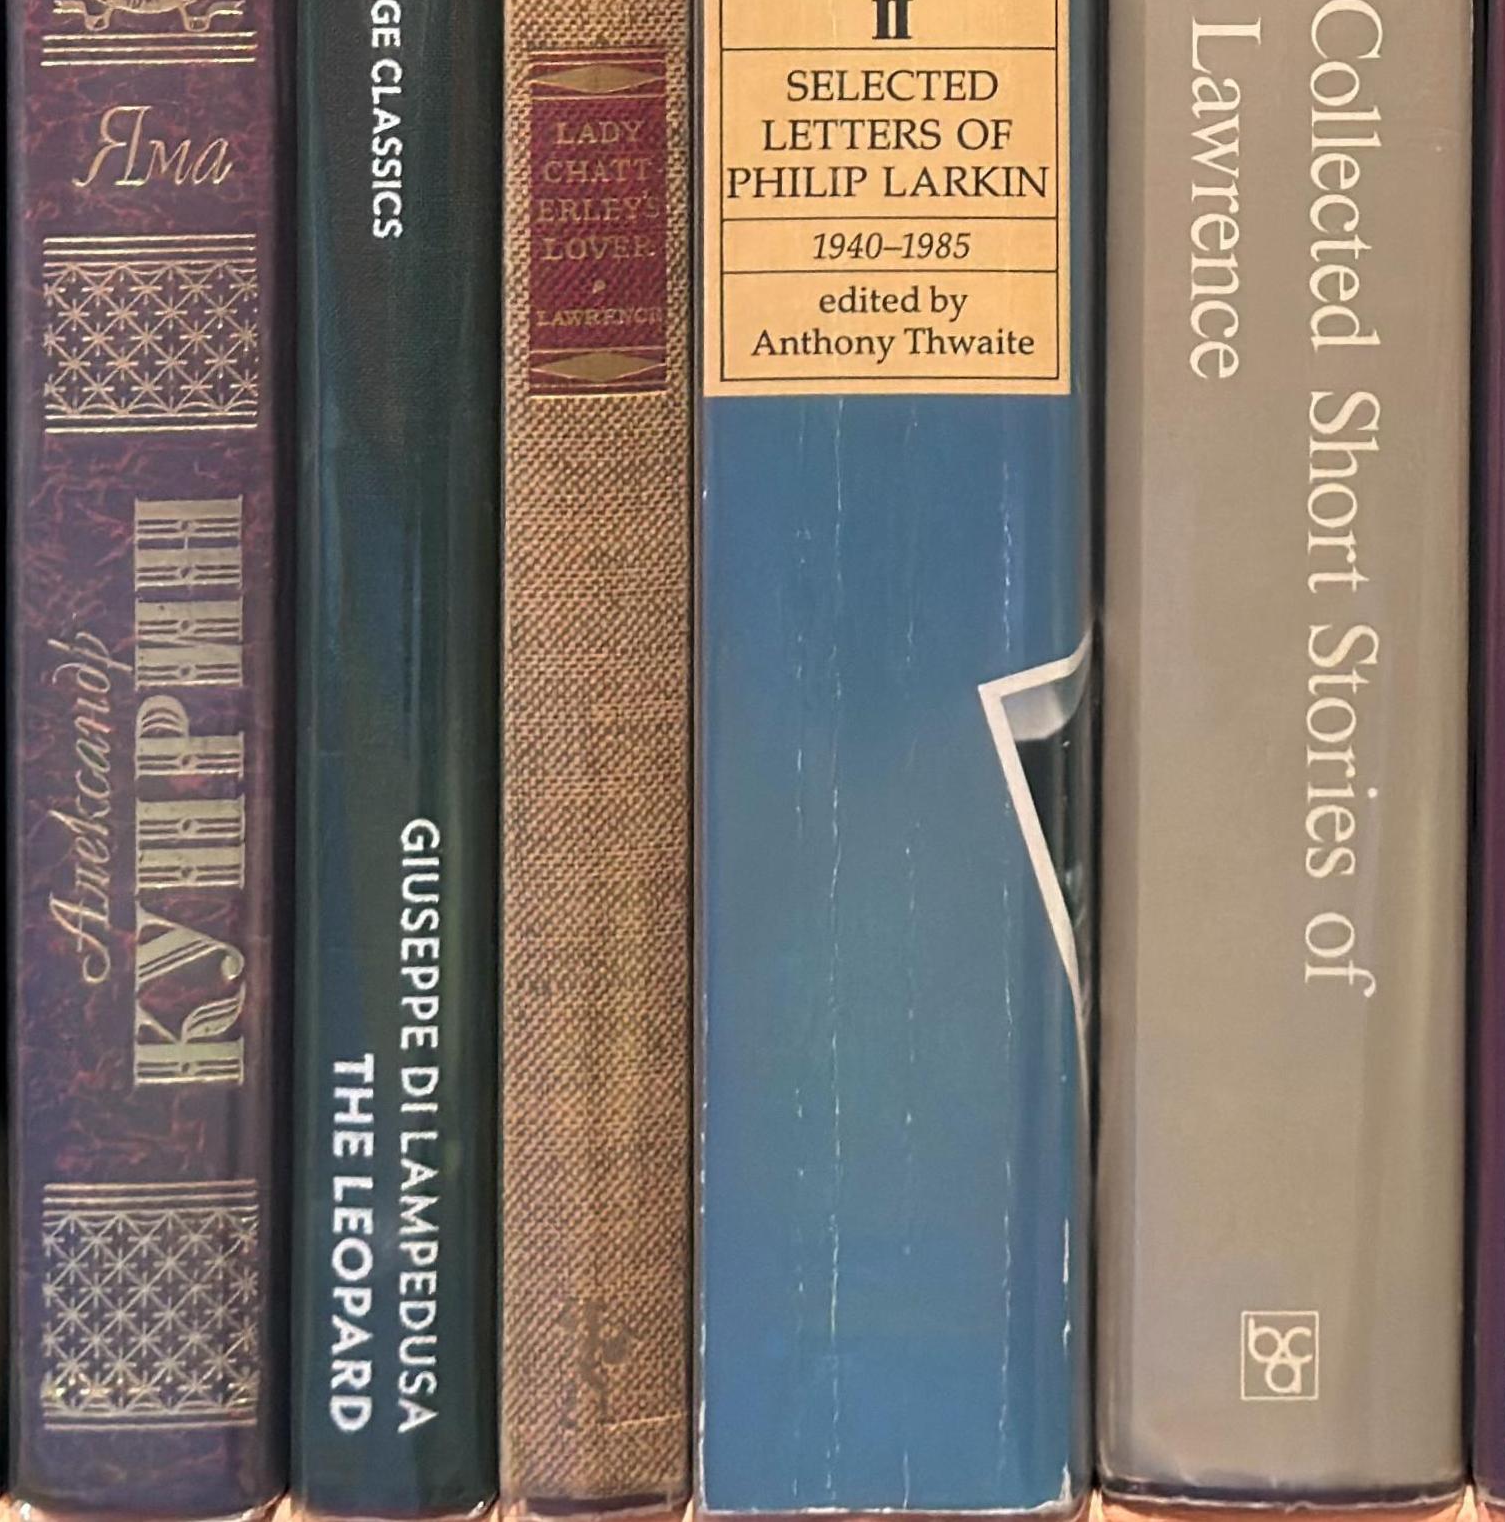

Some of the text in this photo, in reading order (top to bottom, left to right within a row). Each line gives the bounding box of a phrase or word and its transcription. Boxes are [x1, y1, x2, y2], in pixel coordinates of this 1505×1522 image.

[786, 69, 999, 103] SELECTED
[73, 105, 231, 188] Яма
[372, 62, 403, 240] CLASSICS
[544, 159, 651, 183] CHATT
[555, 121, 644, 145] LADY
[761, 118, 1012, 152] LETTERS OF
[727, 165, 1048, 201] PHILIP LARKIN
[1189, 16, 1261, 380] Lawrence
[751, 327, 1034, 365] Anthony Thwaite
[817, 286, 968, 322] edited by
[1307, 389, 1382, 594] Short
[134, 494, 245, 1086] КУПРИН
[1305, 623, 1380, 879] Stories
[1303, 910, 1375, 998] of
[398, 819, 441, 1435] GIUSEPPE DI LAMPEDUSA
[330, 1054, 373, 1433] THE LEOPARD
